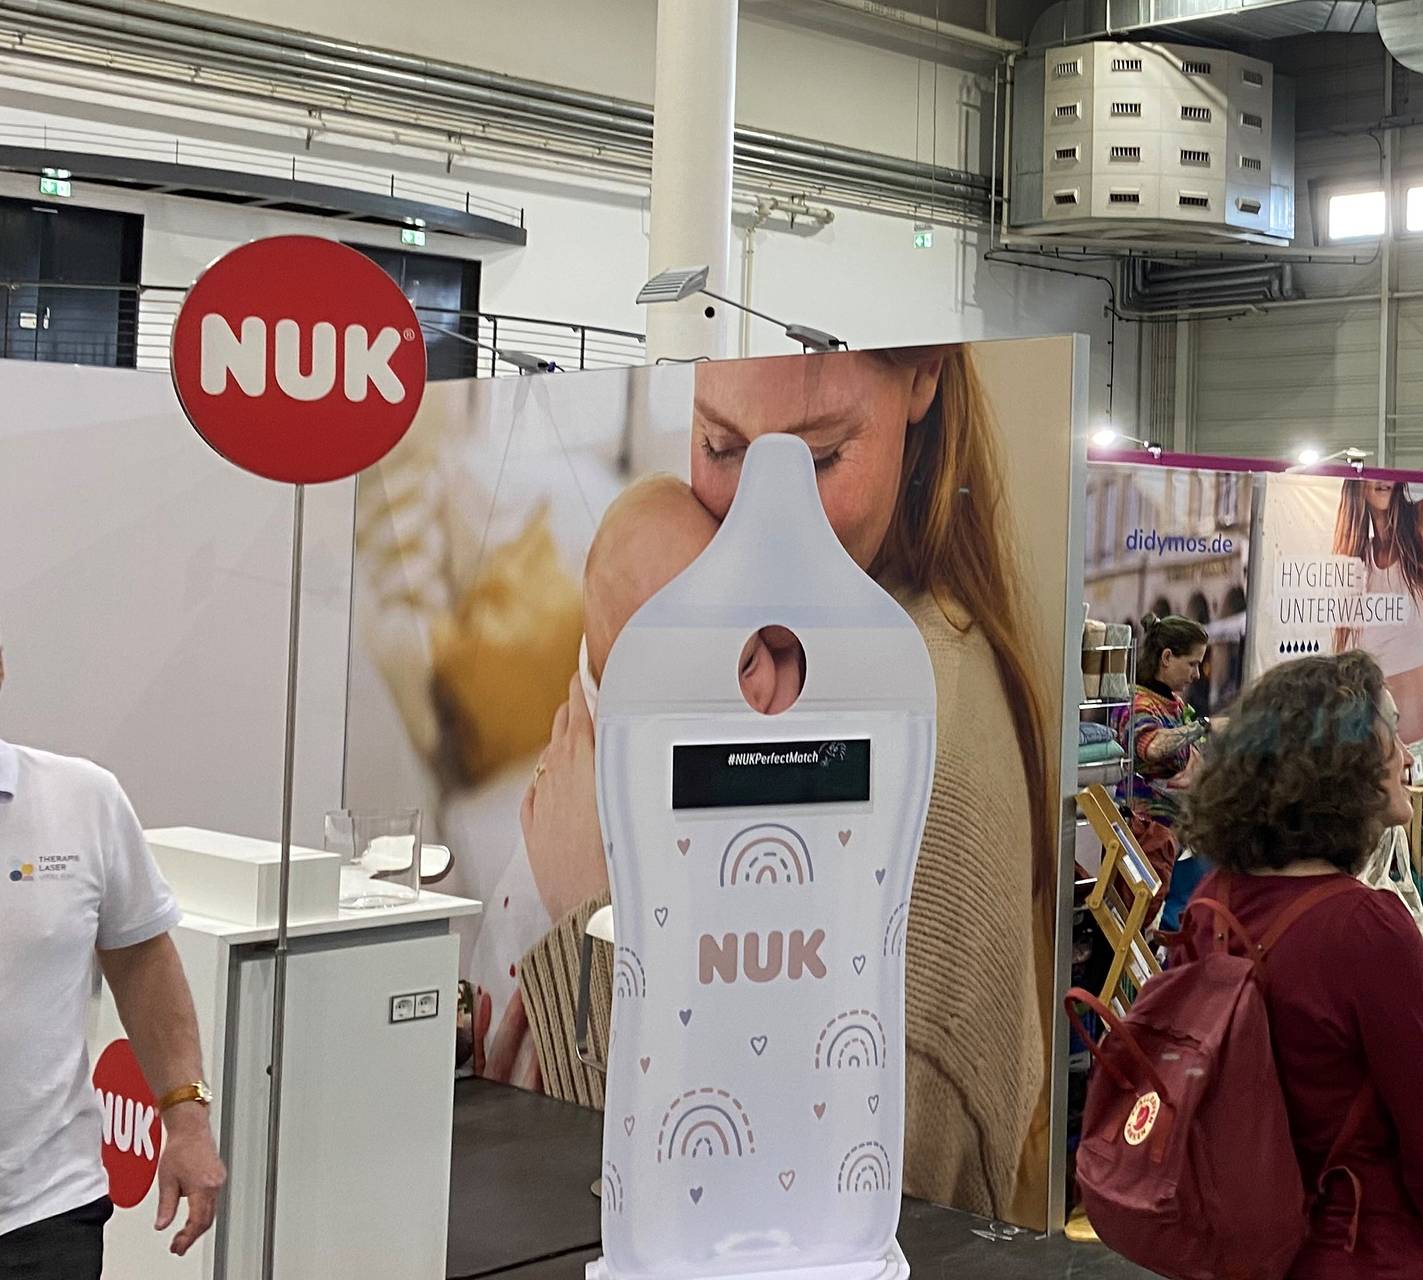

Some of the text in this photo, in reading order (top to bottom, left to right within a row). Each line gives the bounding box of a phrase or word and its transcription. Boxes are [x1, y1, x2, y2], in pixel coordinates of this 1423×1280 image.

[1125, 528, 1233, 557] didymos.de
[1280, 562, 1362, 588] HYGIENE-
[727, 751, 819, 767] #NUKPerfectMatch
[39, 864, 66, 872] LASER
[698, 928, 827, 985] NUK
